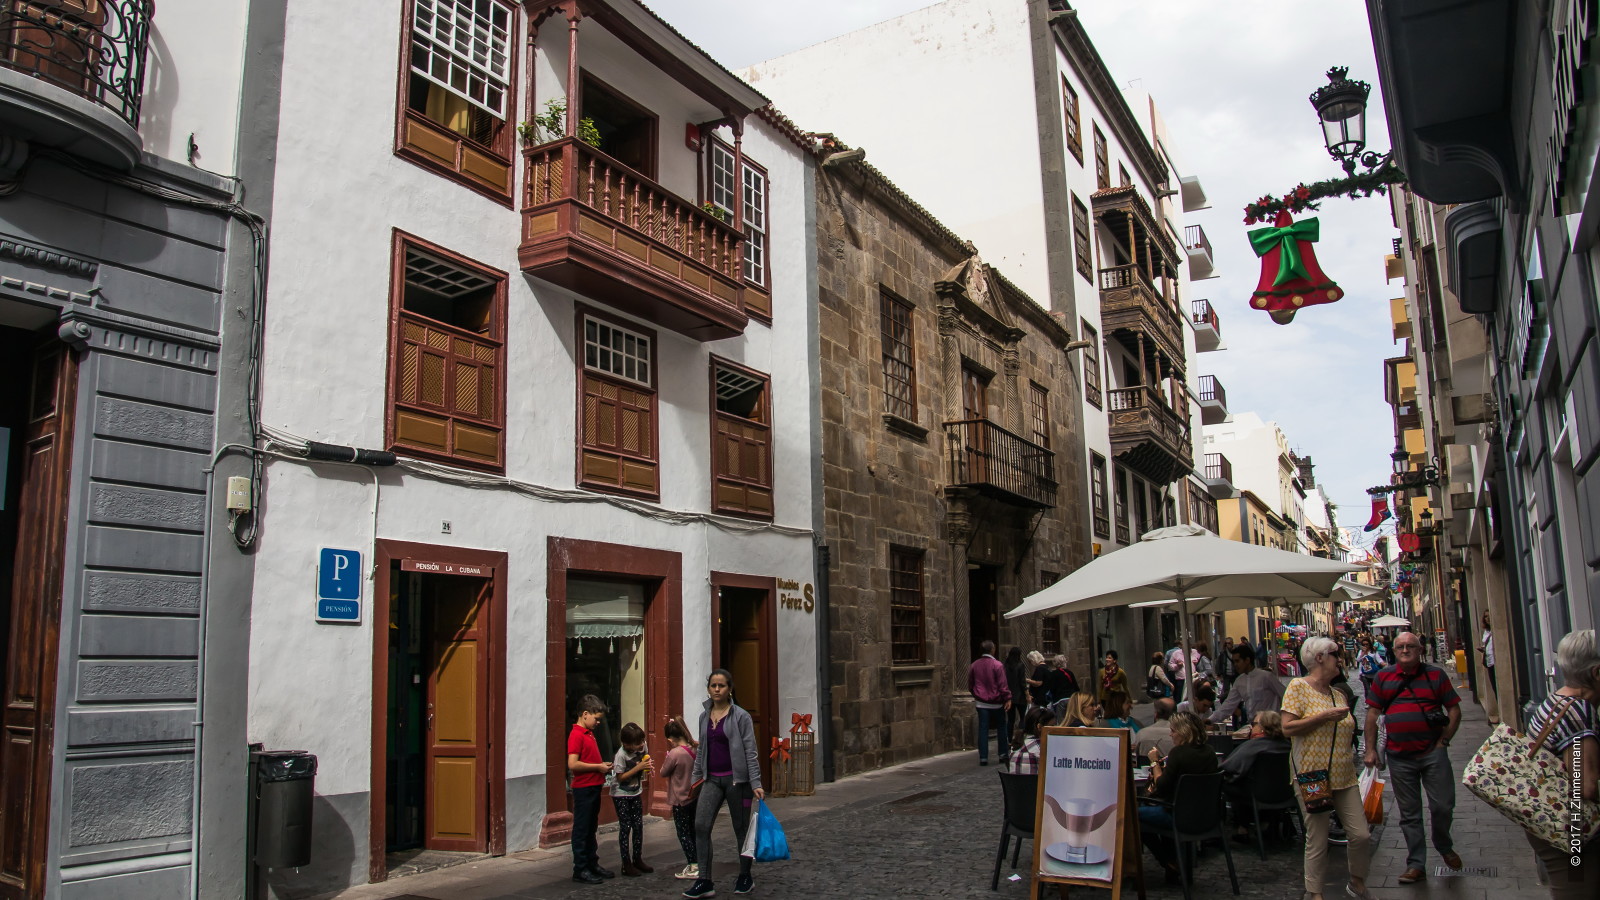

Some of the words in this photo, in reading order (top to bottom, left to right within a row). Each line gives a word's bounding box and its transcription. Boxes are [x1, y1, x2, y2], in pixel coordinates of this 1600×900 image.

[442, 522, 451, 531] 24
[332, 553, 349, 580] P
[415, 562, 440, 571] PENSIÓN
[459, 567, 481, 575] CUBANA
[780, 592, 802, 610] Pérez
[325, 604, 353, 613] PENSIÓN
[1053, 756, 1072, 769] Latte
[1074, 757, 1111, 770] Macciato
